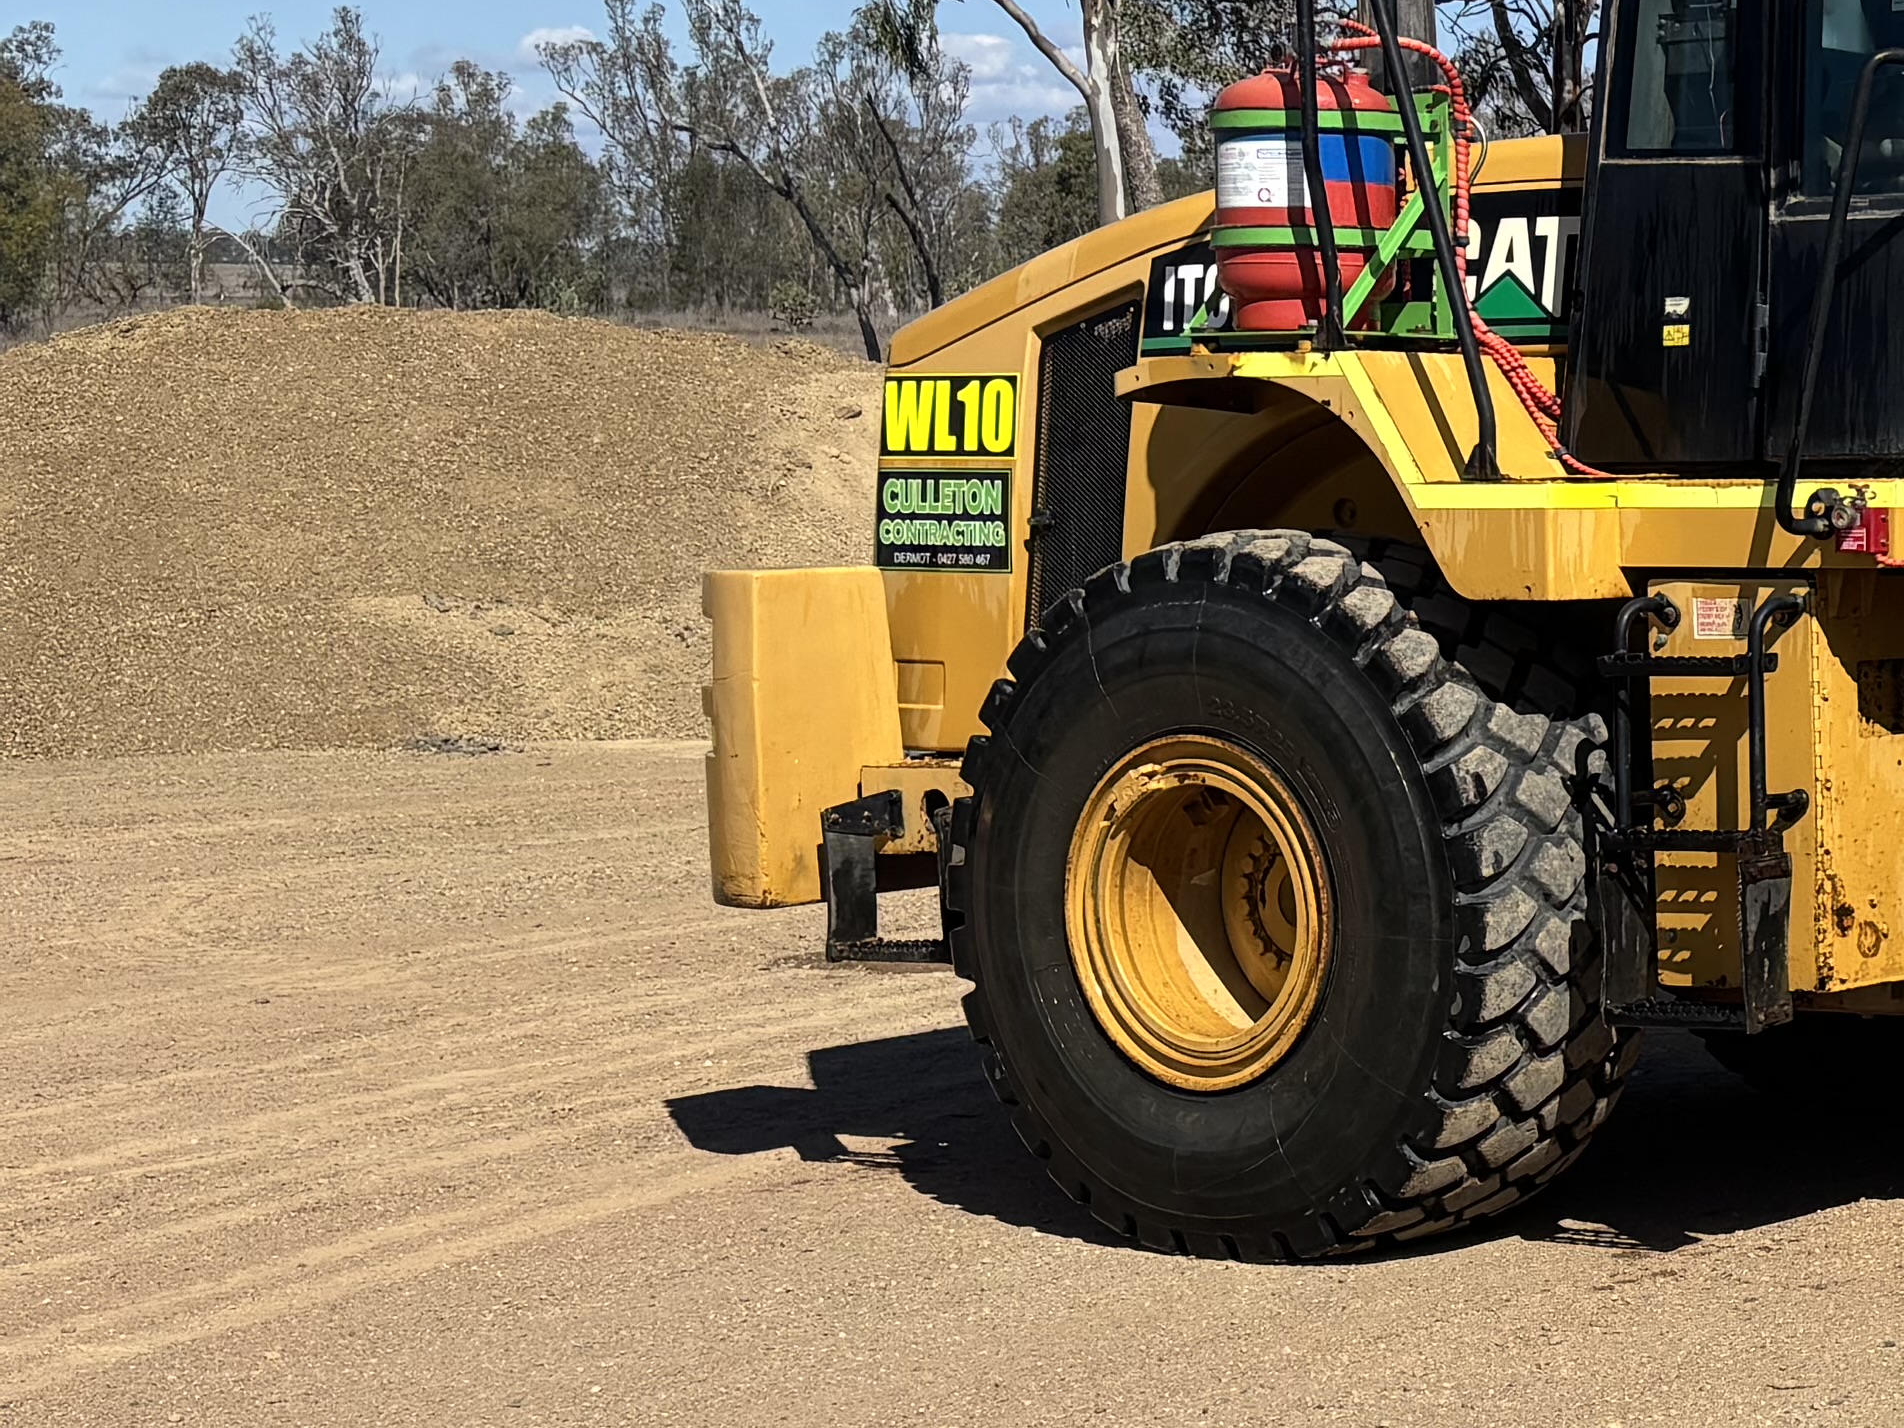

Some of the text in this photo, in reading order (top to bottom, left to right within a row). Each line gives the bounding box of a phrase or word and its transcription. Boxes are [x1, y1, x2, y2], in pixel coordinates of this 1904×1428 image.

[884, 378, 1014, 452] WL10
[882, 478, 1002, 515] CULLETON
[879, 518, 1006, 547] CONTRACTING
[893, 552, 931, 564] DERMOT
[937, 553, 957, 565] 0427
